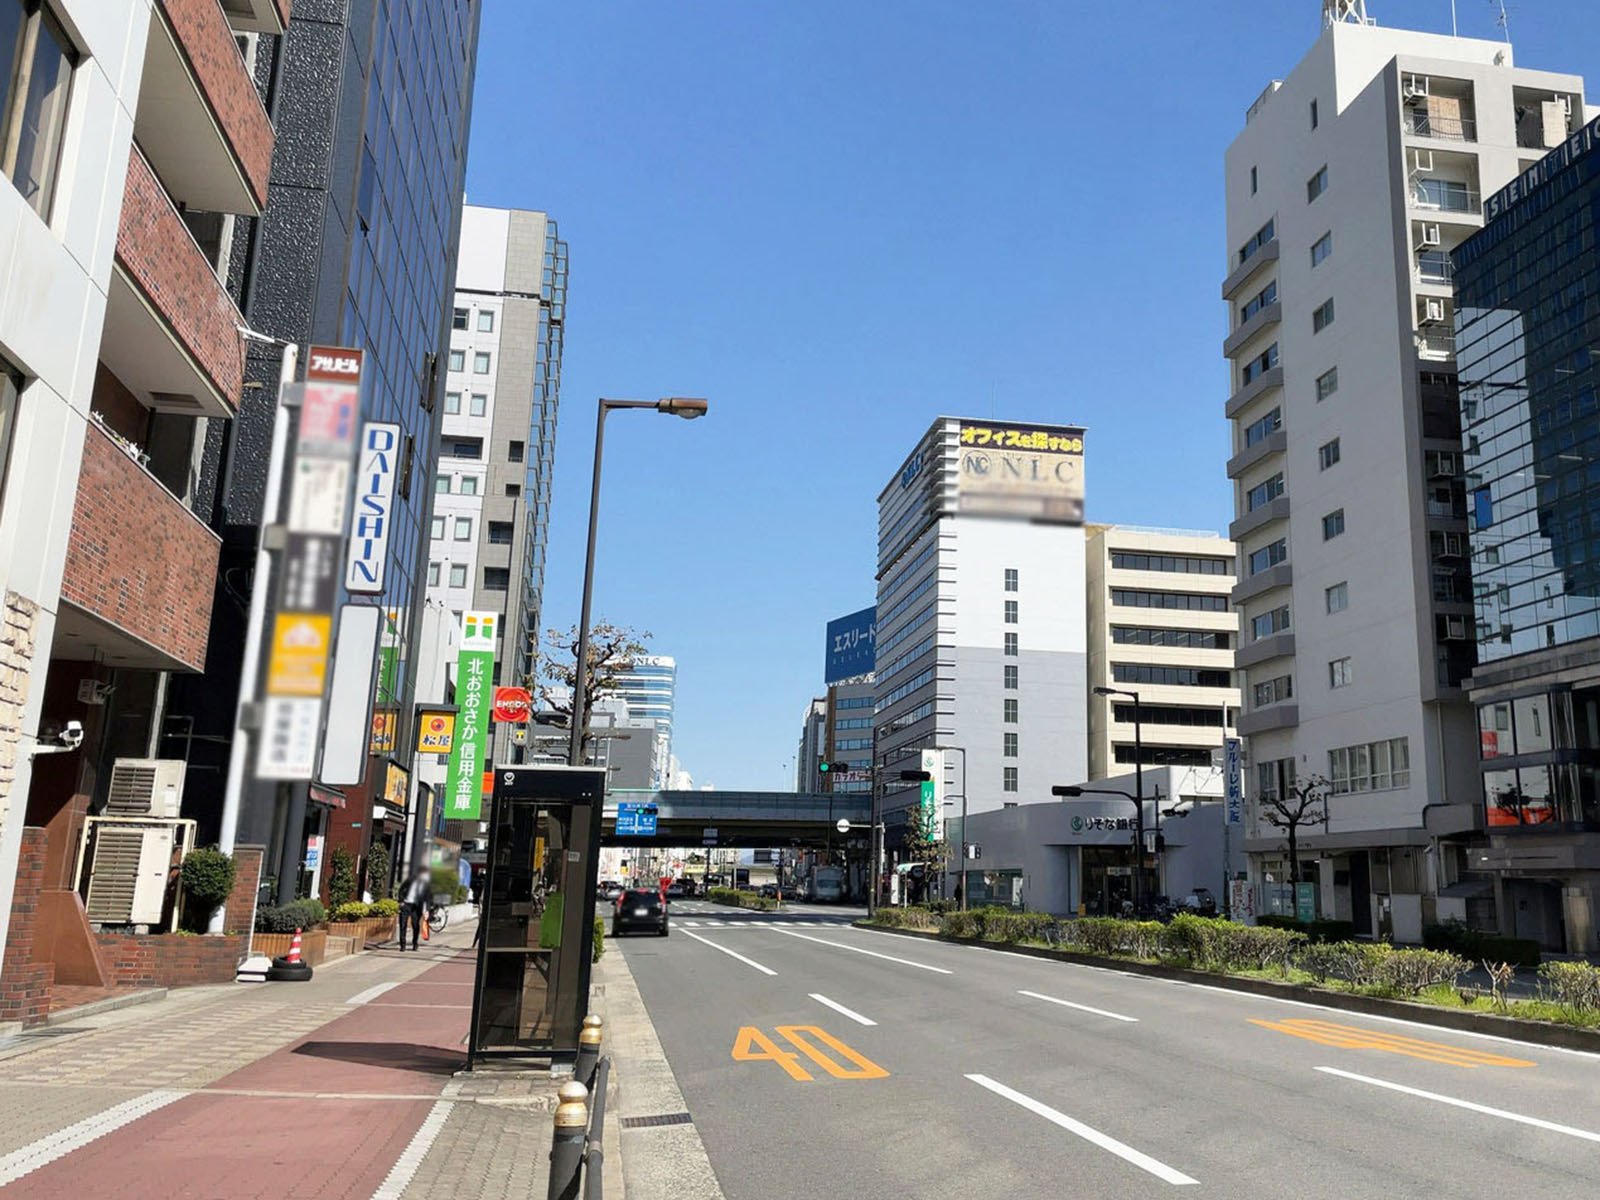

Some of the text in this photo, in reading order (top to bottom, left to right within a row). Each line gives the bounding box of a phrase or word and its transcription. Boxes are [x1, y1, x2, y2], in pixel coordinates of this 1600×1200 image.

[960, 427, 1083, 452] オフィスを探すなら
[352, 429, 394, 583] DAISHIN
[423, 735, 451, 746] 松屋
[454, 658, 485, 811] 北おおさか信用金庫
[1085, 818, 1139, 831] りそな銀行
[731, 1025, 890, 1081] 40
